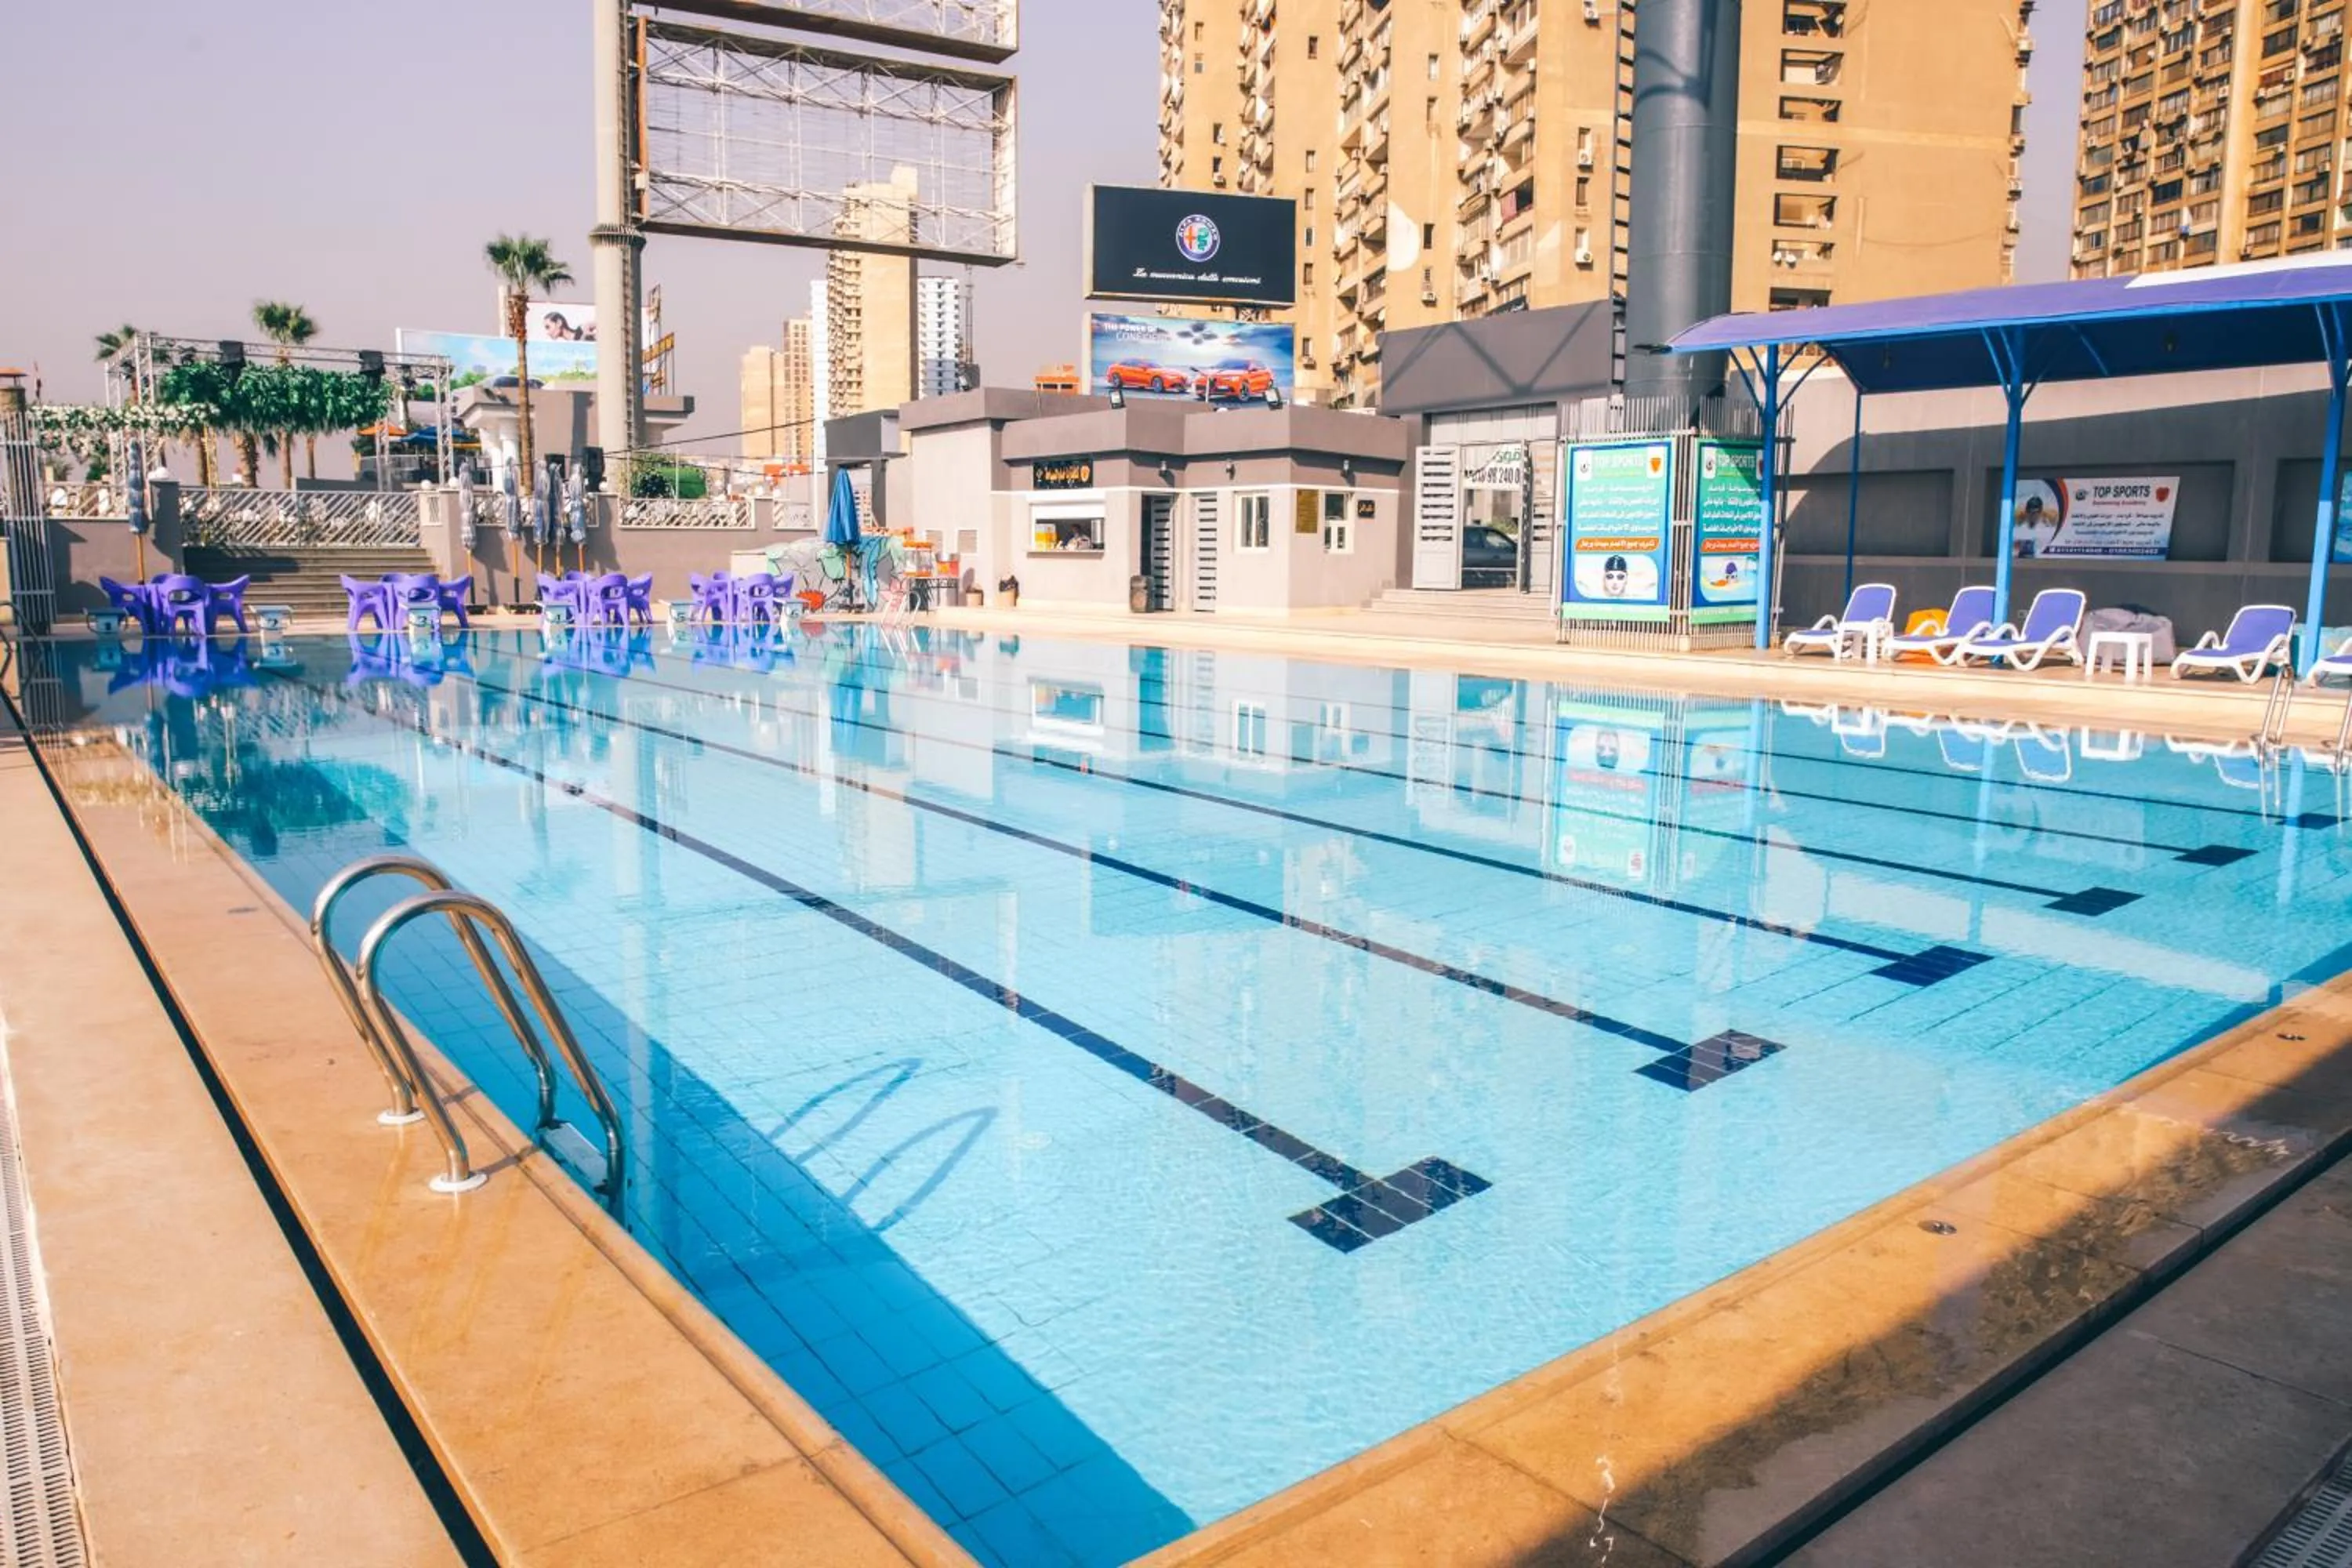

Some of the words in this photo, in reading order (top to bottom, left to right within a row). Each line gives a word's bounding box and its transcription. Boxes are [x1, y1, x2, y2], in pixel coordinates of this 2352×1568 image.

[2093, 485, 2111, 498] TOP
[2113, 485, 2151, 498] SPORTS
[417, 615, 427, 627] 3
